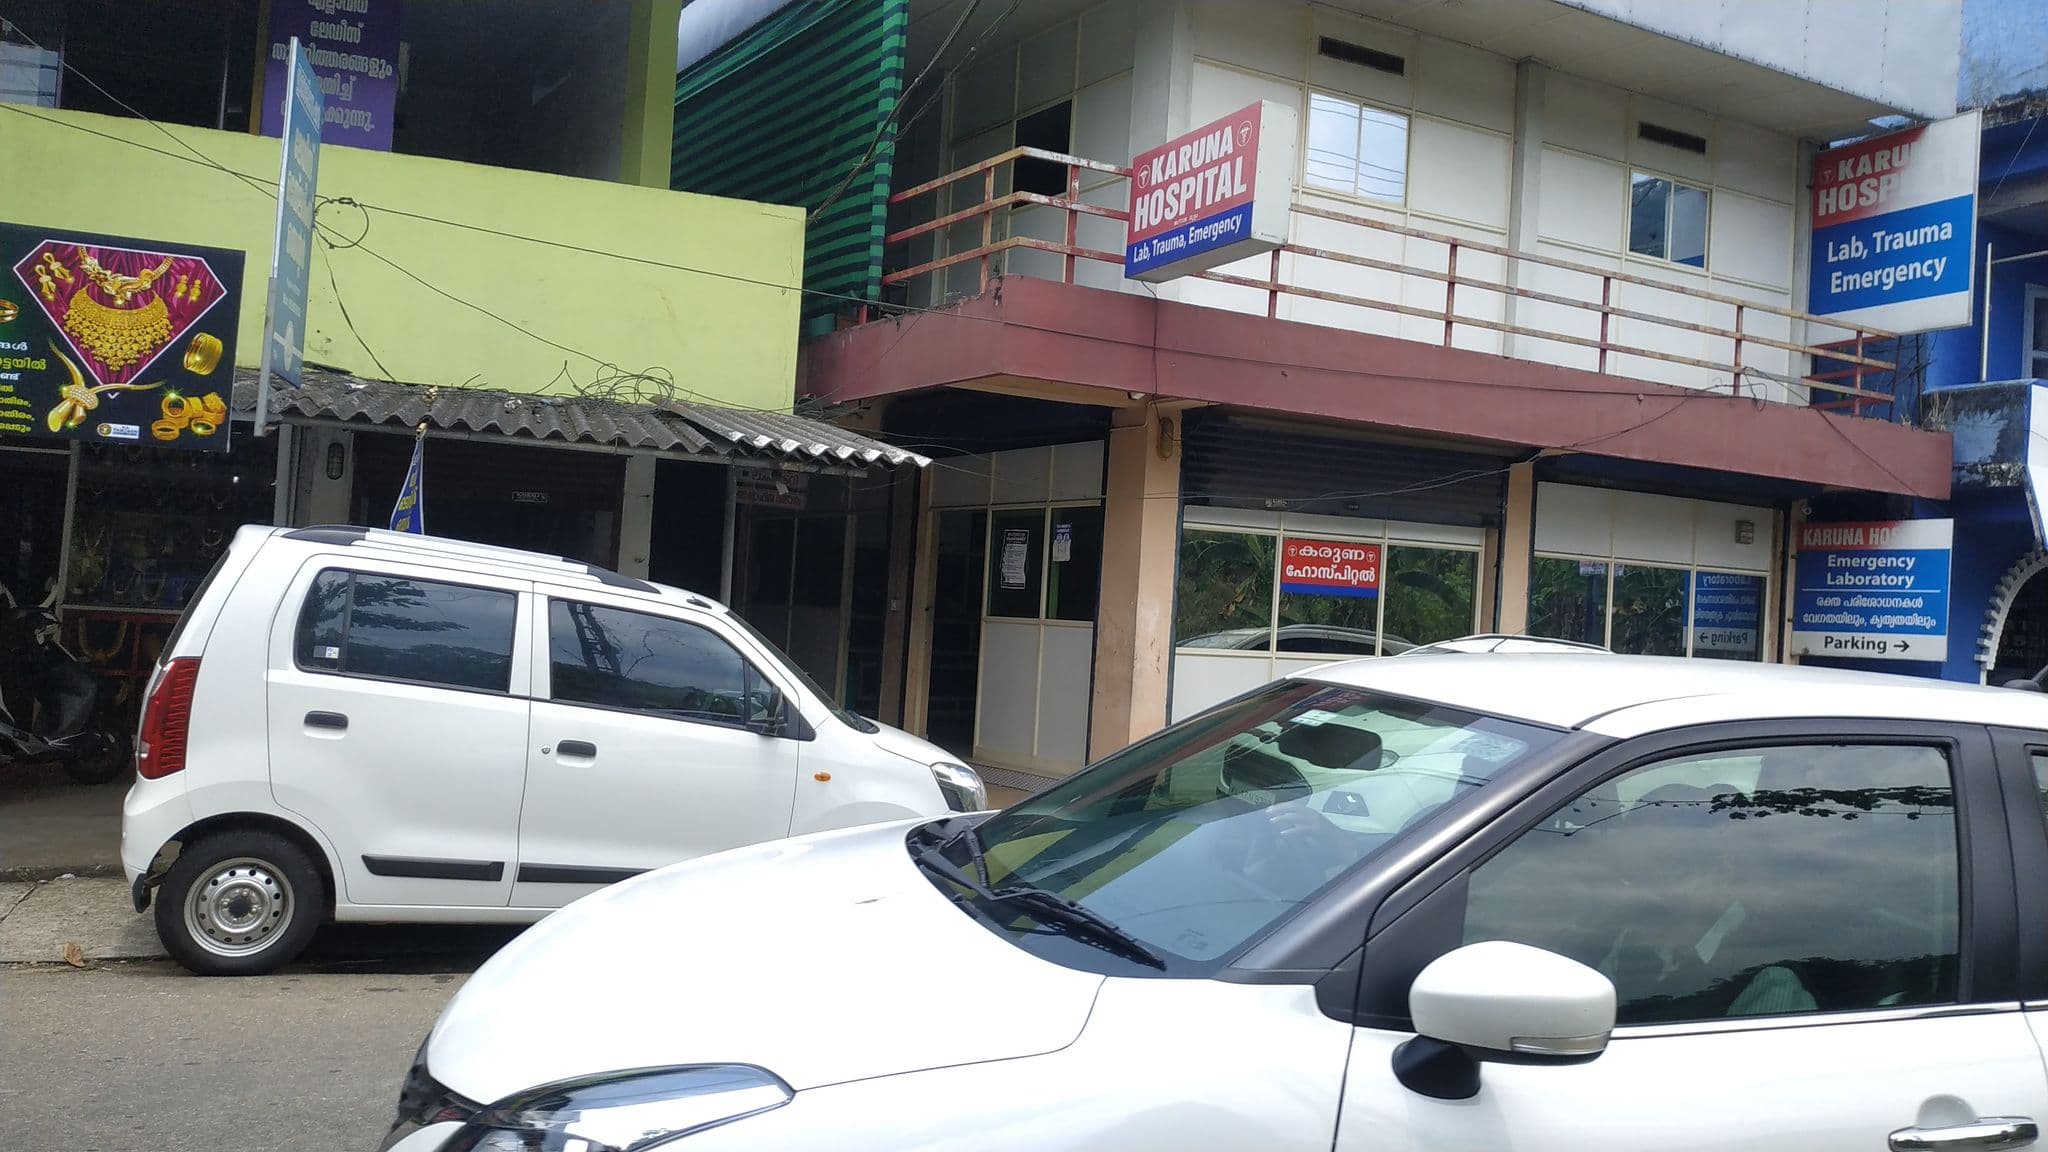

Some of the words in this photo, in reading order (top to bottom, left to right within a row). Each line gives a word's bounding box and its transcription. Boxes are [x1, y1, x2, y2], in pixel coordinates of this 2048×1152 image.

[1150, 125, 1234, 186] KARUNA
[1134, 155, 1247, 232] HOSPITAL
[1133, 243, 1151, 264] Lab,
[1151, 234, 1187, 257] Trauma,
[1188, 213, 1243, 244] Emergency
[1827, 235, 1869, 263] Lab,
[1872, 221, 1953, 254] Trauma
[1830, 256, 1948, 294] Emergency
[1803, 528, 1864, 546] KARUNA
[1299, 545, 1365, 563] കരുണ
[1827, 554, 1916, 571] Emergency
[1286, 564, 1375, 585] ഹോസ്പിറ്റൽ
[1826, 571, 1915, 589] Laboratory
[1843, 594, 1924, 609] പരിശോധനകൾ
[1824, 635, 1887, 654] Parking
